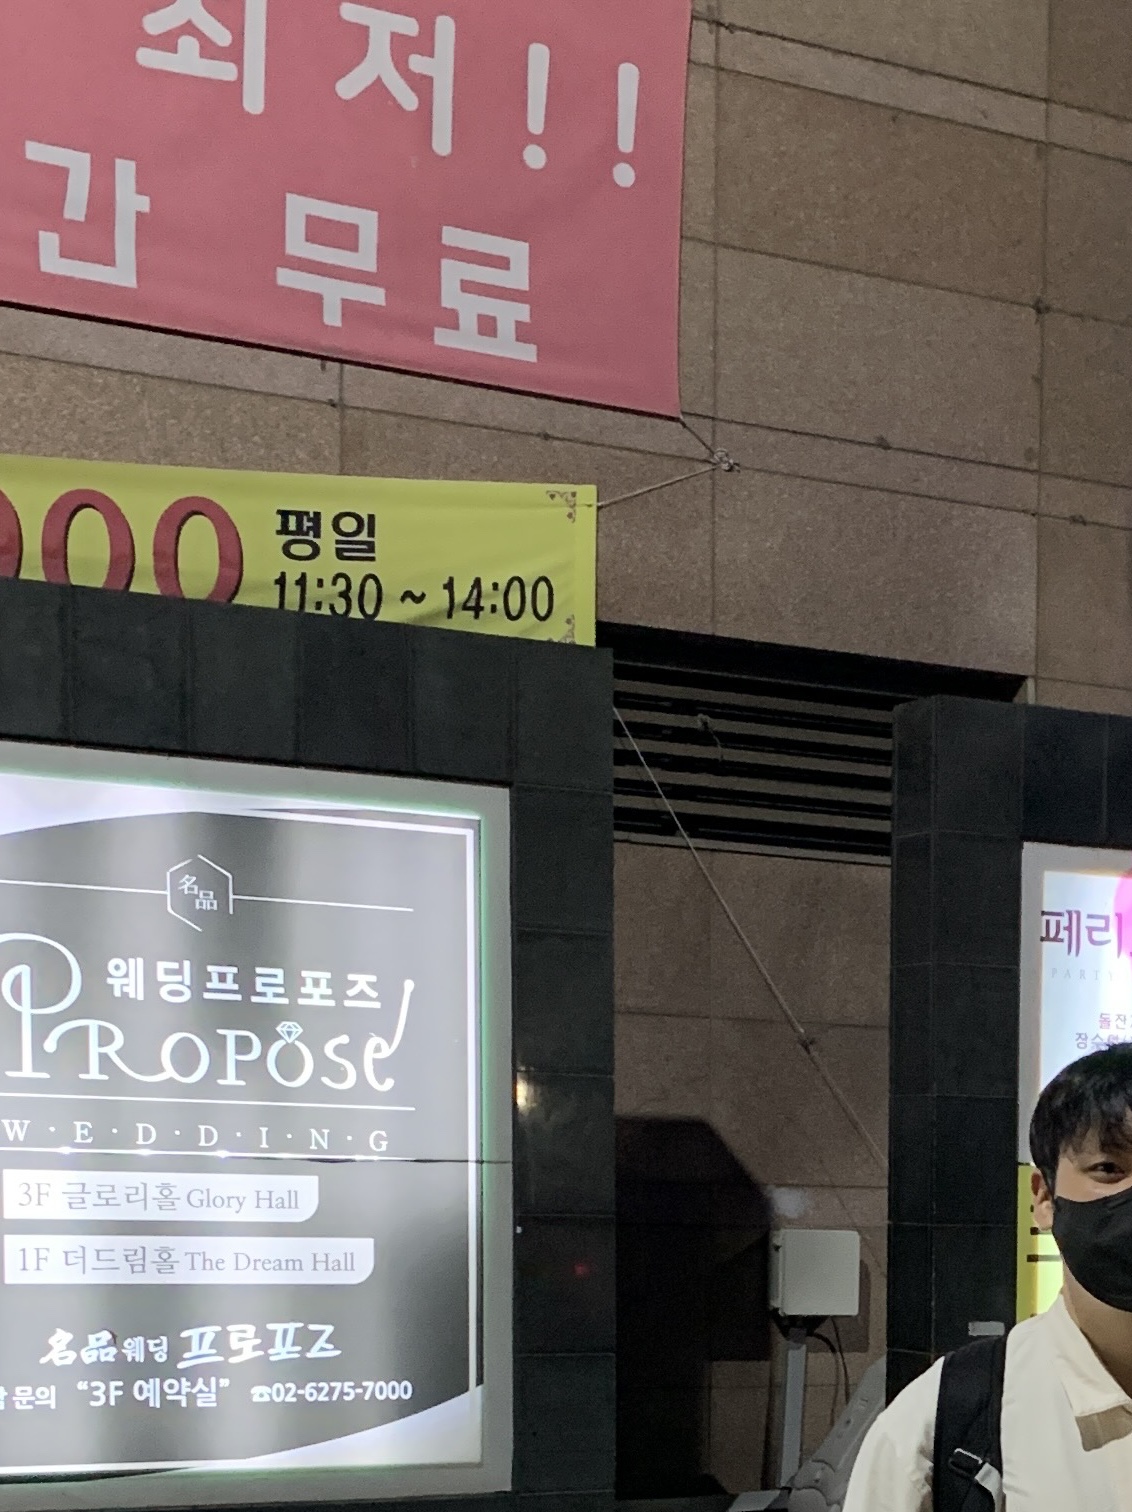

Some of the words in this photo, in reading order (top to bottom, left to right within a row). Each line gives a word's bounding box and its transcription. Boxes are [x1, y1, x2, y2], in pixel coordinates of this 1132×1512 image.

[275, 192, 538, 362] 무료
[275, 509, 377, 562] 평일
[441, 576, 555, 622] 14:00
[106, 957, 382, 1010] 웨딩프로포즈
[18, 1182, 51, 1207] 3F
[61, 1181, 181, 1212] 글로리홀
[186, 1188, 247, 1214] Glory
[254, 1189, 300, 1210] Hall
[19, 1247, 50, 1271] 1F
[63, 1245, 180, 1275] 더드림홀
[185, 1251, 226, 1272] The
[233, 1252, 304, 1272] Dream
[311, 1252, 356, 1272] Hall
